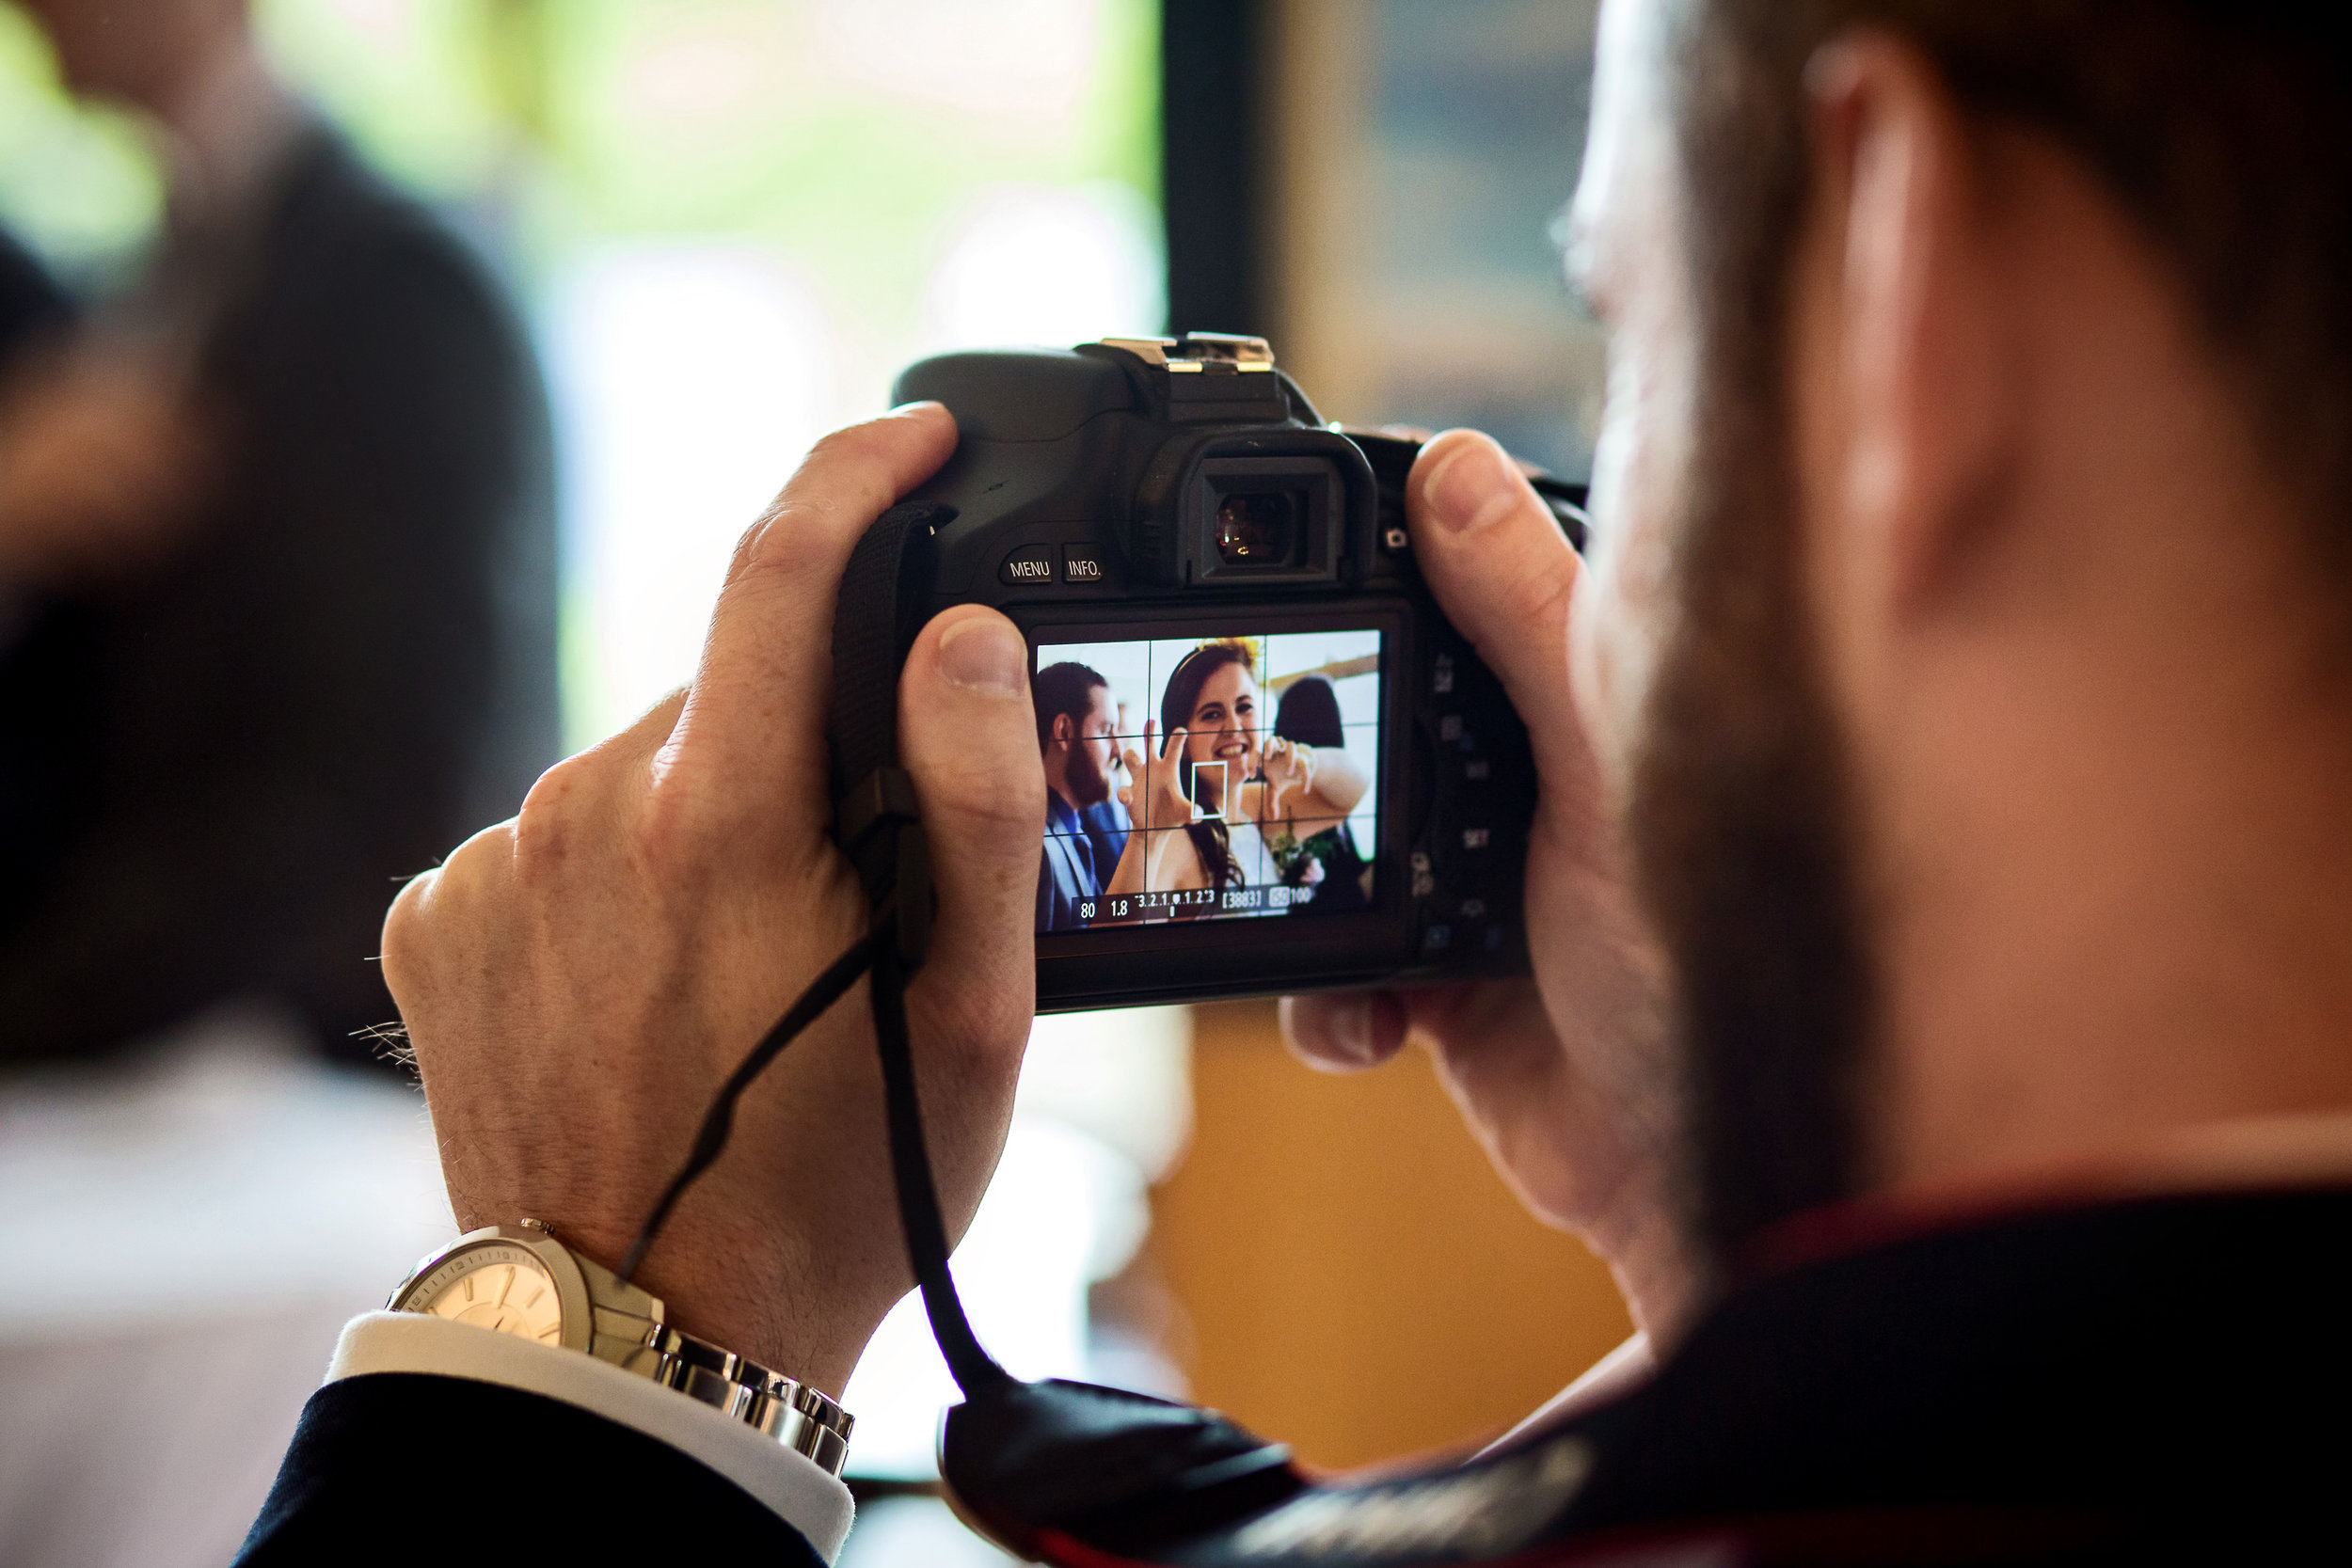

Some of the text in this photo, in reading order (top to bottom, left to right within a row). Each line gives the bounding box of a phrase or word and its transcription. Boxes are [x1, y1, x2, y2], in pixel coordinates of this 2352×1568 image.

[1009, 562, 1050, 578] MENU
[1068, 561, 1102, 576] INFO.
[1080, 902, 1096, 919] 80
[1111, 900, 1128, 917] 1.8
